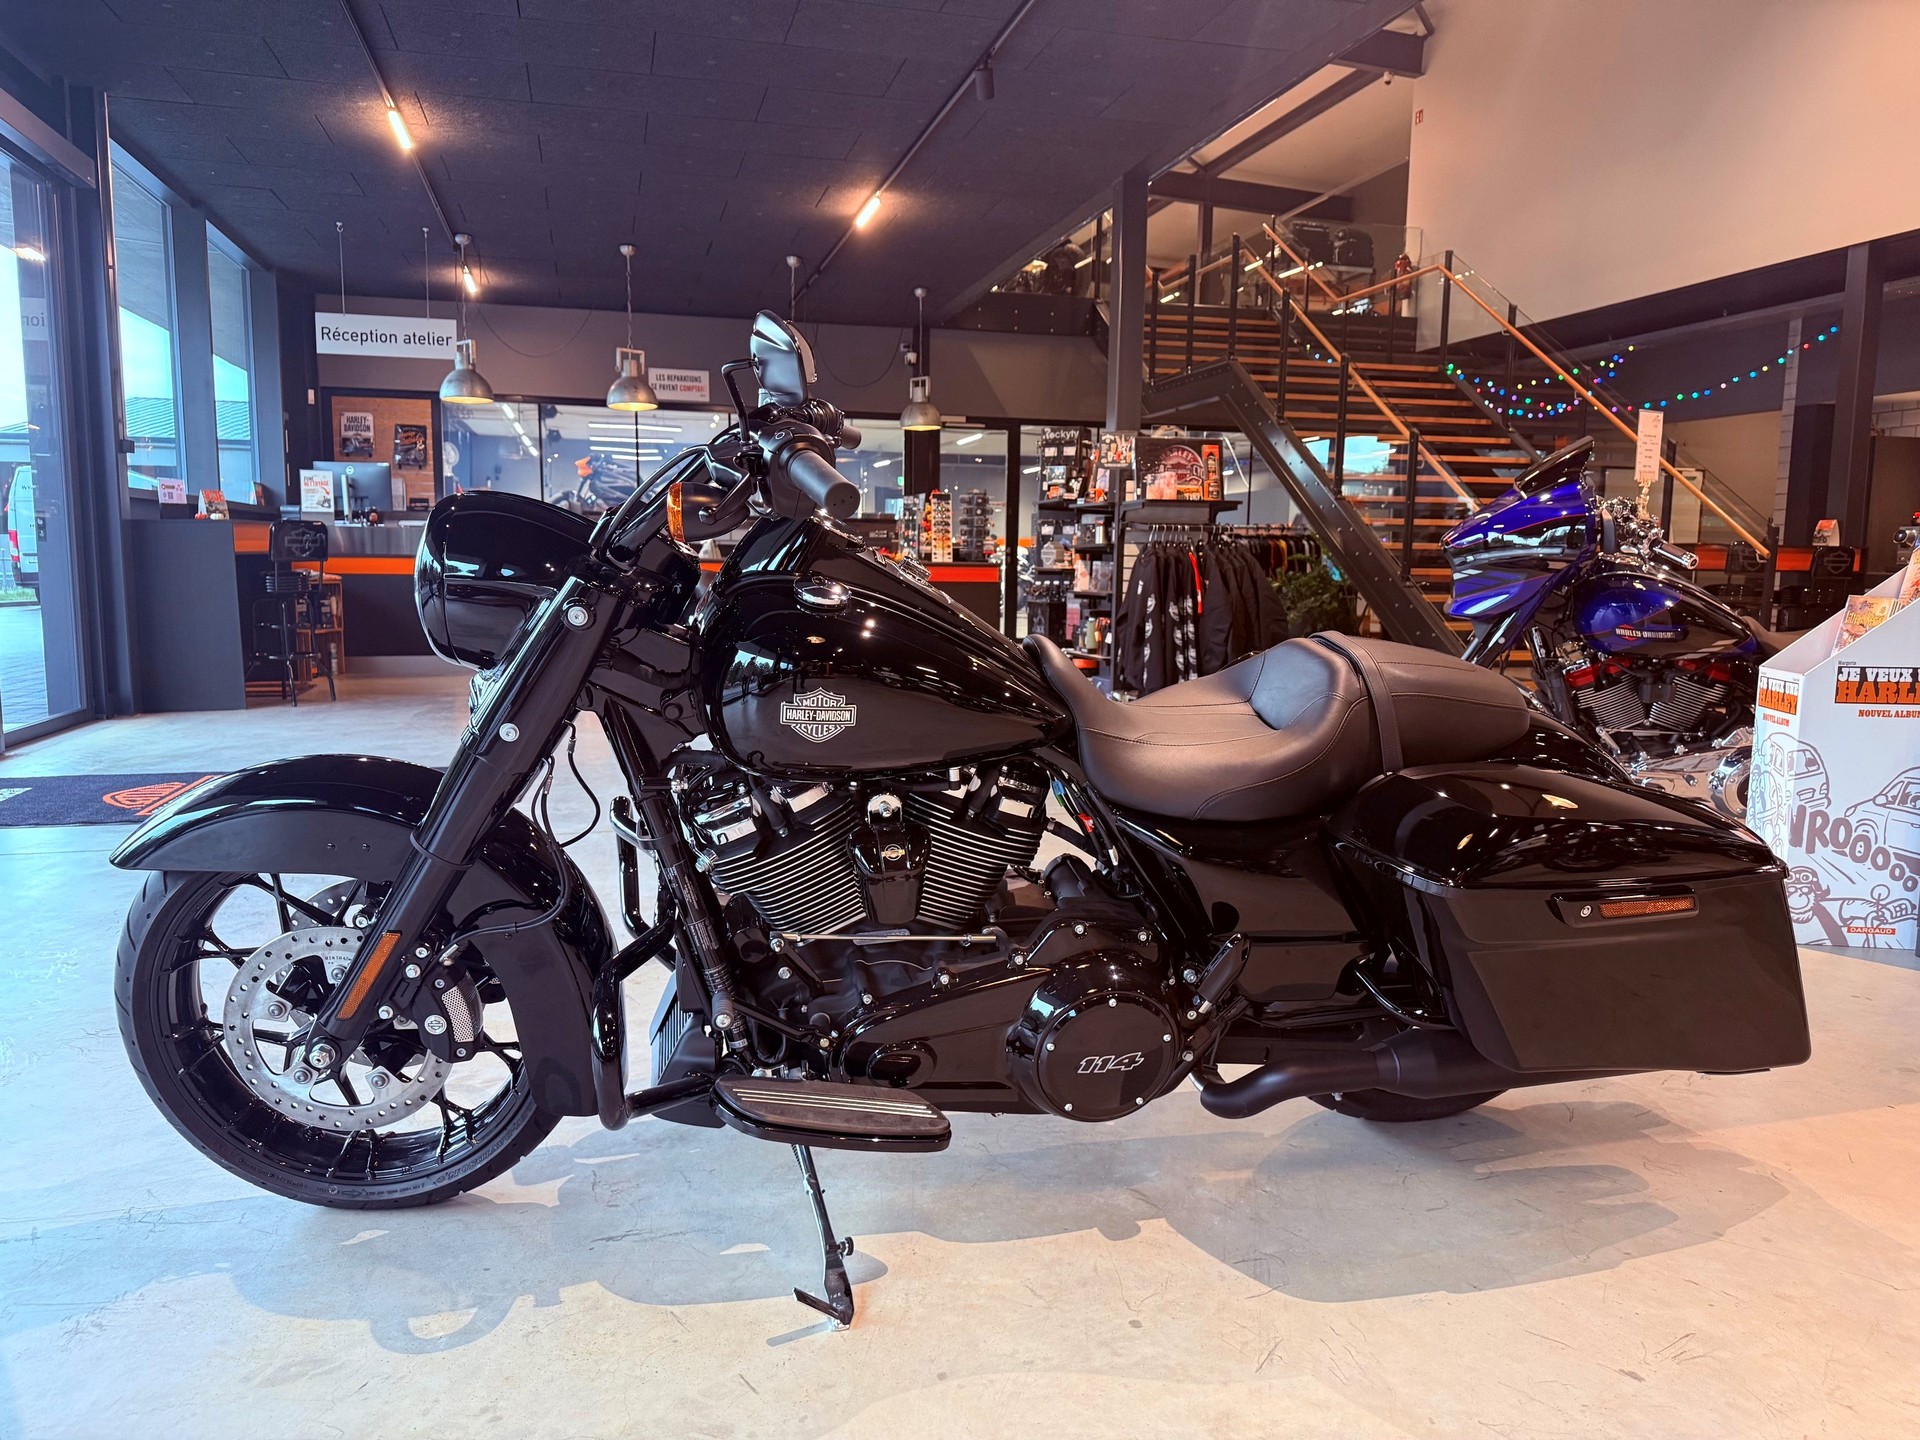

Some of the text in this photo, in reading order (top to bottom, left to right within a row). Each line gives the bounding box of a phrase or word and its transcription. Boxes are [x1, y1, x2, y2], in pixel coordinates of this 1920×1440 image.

[321, 326, 453, 346] Réception atelier
[660, 383, 679, 391] PAYENT
[344, 423, 371, 432] DAVIDSON
[1838, 667, 1860, 682] JE
[1865, 668, 1913, 683] VEUX
[1836, 681, 1920, 704] HARL
[802, 694, 838, 708] MOTOR
[1758, 688, 1798, 715] HARLEY
[786, 708, 852, 721] HARLEY-DAVIDSON
[1858, 709, 1893, 718] NOUVEL
[800, 723, 836, 738] CYCLES
[1849, 927, 1893, 935] DARGAUD
[1076, 1051, 1145, 1074] 114
